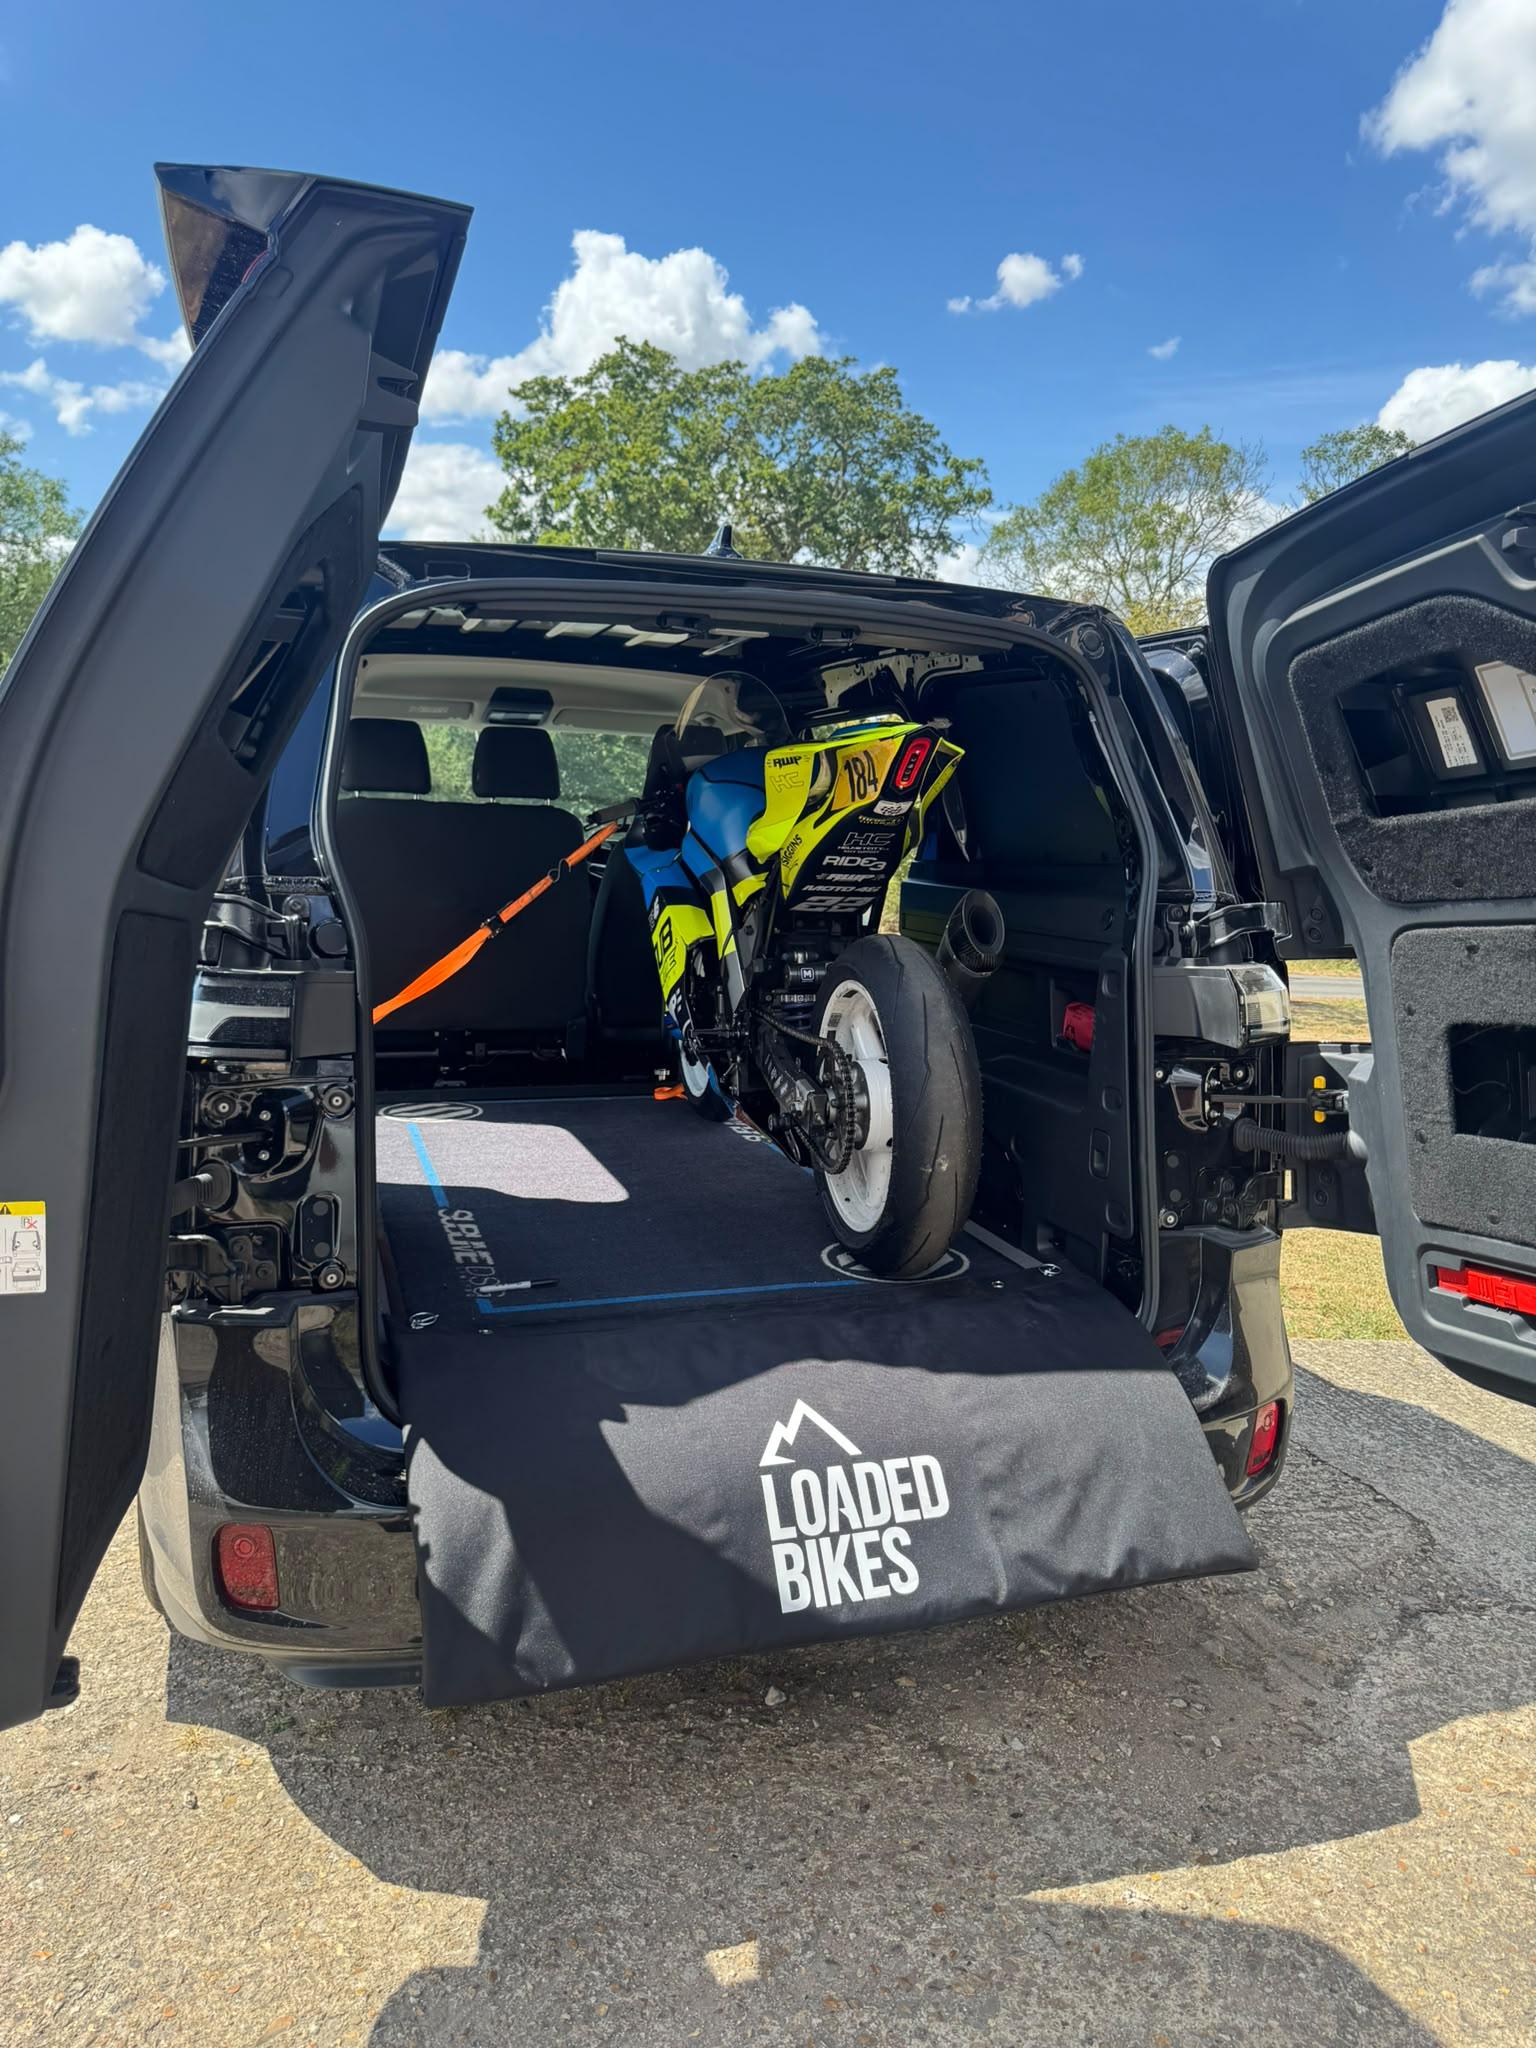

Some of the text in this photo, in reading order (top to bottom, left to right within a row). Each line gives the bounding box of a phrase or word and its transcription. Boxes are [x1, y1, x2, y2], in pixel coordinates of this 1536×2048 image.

[844, 749, 878, 802] 184
[843, 831, 896, 846] HC
[760, 1454, 950, 1542] LOADED
[771, 1526, 920, 1614] BIKES
